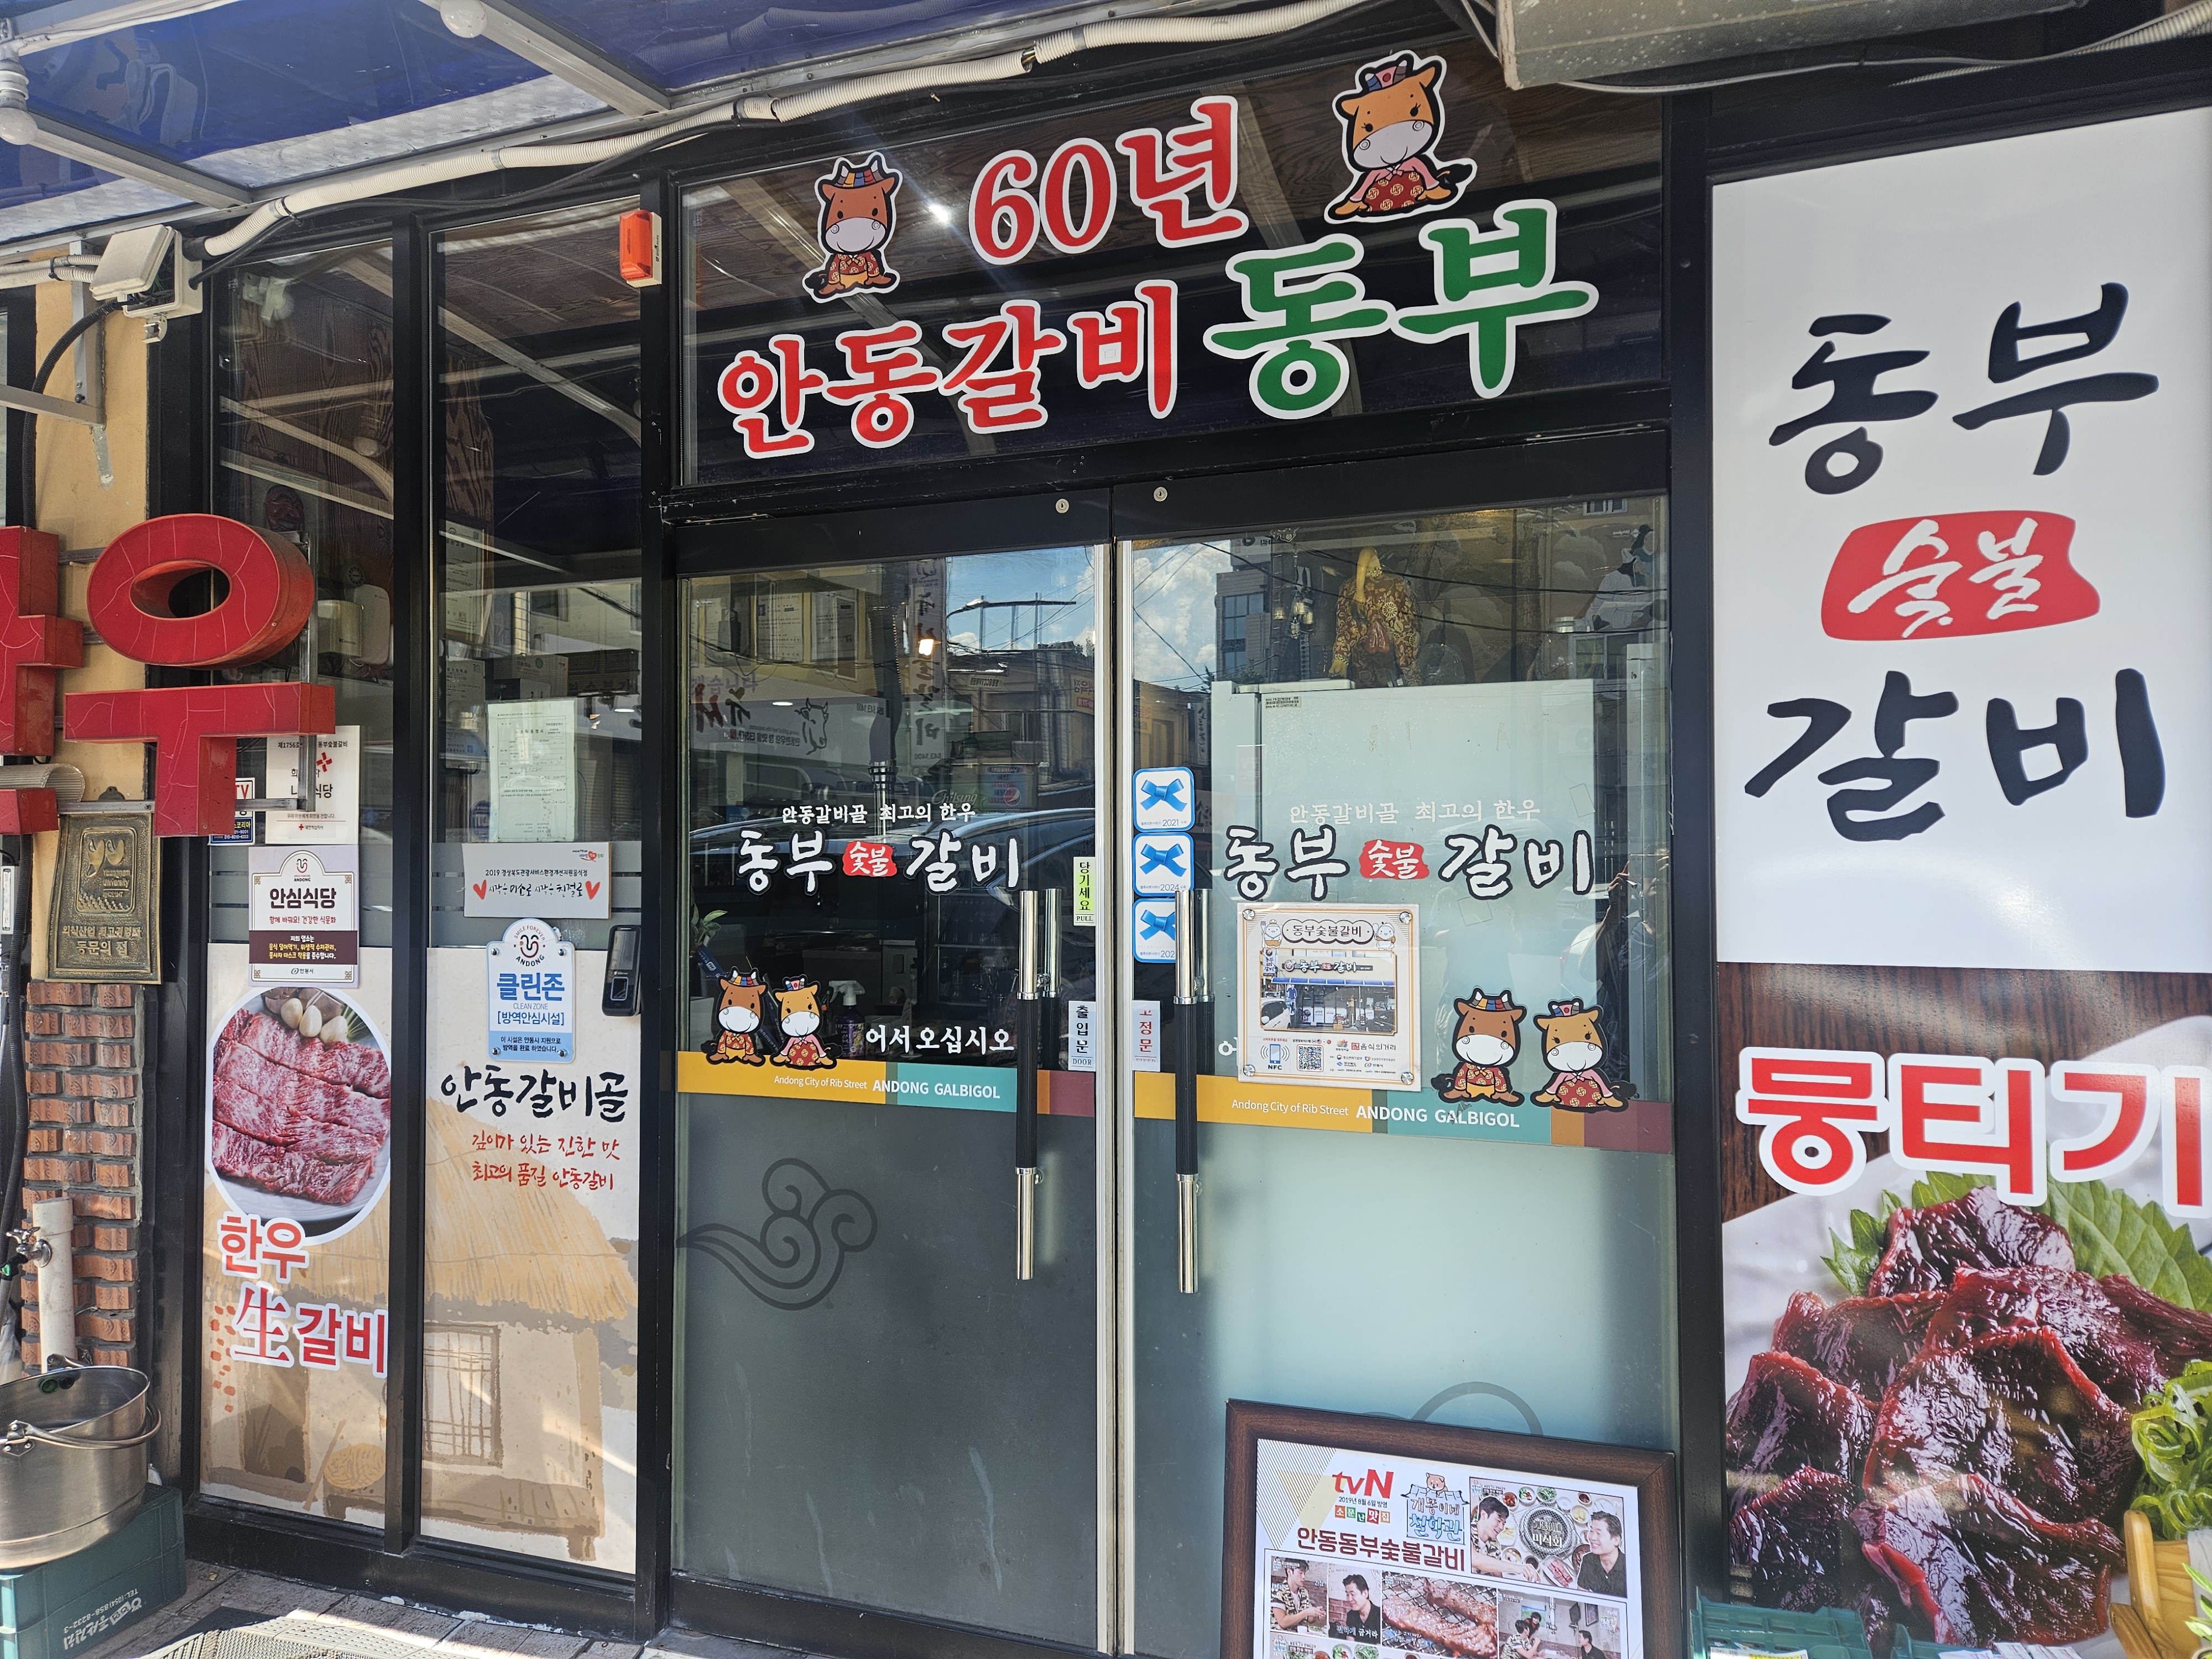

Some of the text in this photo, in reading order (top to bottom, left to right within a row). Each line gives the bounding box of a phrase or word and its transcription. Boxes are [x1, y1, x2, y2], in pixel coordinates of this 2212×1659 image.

[972, 97, 1246, 263] 60년
[719, 199, 1599, 458] 안동갈비 동부
[1768, 282, 2159, 495] 동부
[1847, 517, 2044, 639] 숯불
[1744, 667, 2166, 842] 갈비
[782, 802, 976, 825] 안동갈비골 최고의 한우
[1290, 799, 1541, 825] 안동갈비골 최고의 한우
[738, 830, 833, 894] 동부
[849, 841, 889, 875] 숯불
[908, 832, 1020, 893] 갈비
[1227, 828, 1347, 898] 동부
[1368, 839, 1424, 878] 숯불
[1442, 828, 1593, 898] 갈비
[270, 888, 337, 909] 안심식당
[1079, 861, 1091, 911] 당기세요
[301, 916, 319, 924] 건강한
[320, 916, 336, 924] 식문화
[514, 925, 546, 941] SMILE FOREVER
[1292, 925, 1361, 937] 동부숯불갈비
[76, 941, 128, 956] 동문의 집
[515, 954, 545, 967] ANDONG
[1300, 959, 1319, 973] 동부
[1334, 961, 1357, 973] 갈비
[497, 973, 565, 1001] 클린존
[498, 1011, 565, 1026] [방역안심시설]
[1076, 1005, 1089, 1054] 출입문
[865, 1025, 1014, 1054] 어서오십시오
[441, 1065, 628, 1123] 안동갈비골
[774, 1076, 867, 1089] Andong City of Rib Street
[872, 1079, 1000, 1098] ANDONG GALBIGOL
[1232, 1099, 1349, 1115] Andong City of Rib Street
[1356, 1104, 1520, 1128] ANDONG GALBIGOL
[472, 1130, 620, 1160] 깊이가 있는 진한 맛
[1747, 1057, 2203, 1207] 뭉티기
[472, 1161, 613, 1191] 최고의 품질 안동갈비
[220, 1215, 306, 1279] 한우
[1332, 1469, 1394, 1499] tvN
[1339, 1496, 1358, 1505] 2019년
[1411, 1498, 1460, 1516] 개똥이네
[1410, 1514, 1462, 1541] 철학관
[1532, 1534, 1562, 1548] 미식회
[1298, 1527, 1465, 1572] 안동동부숯불갈비
